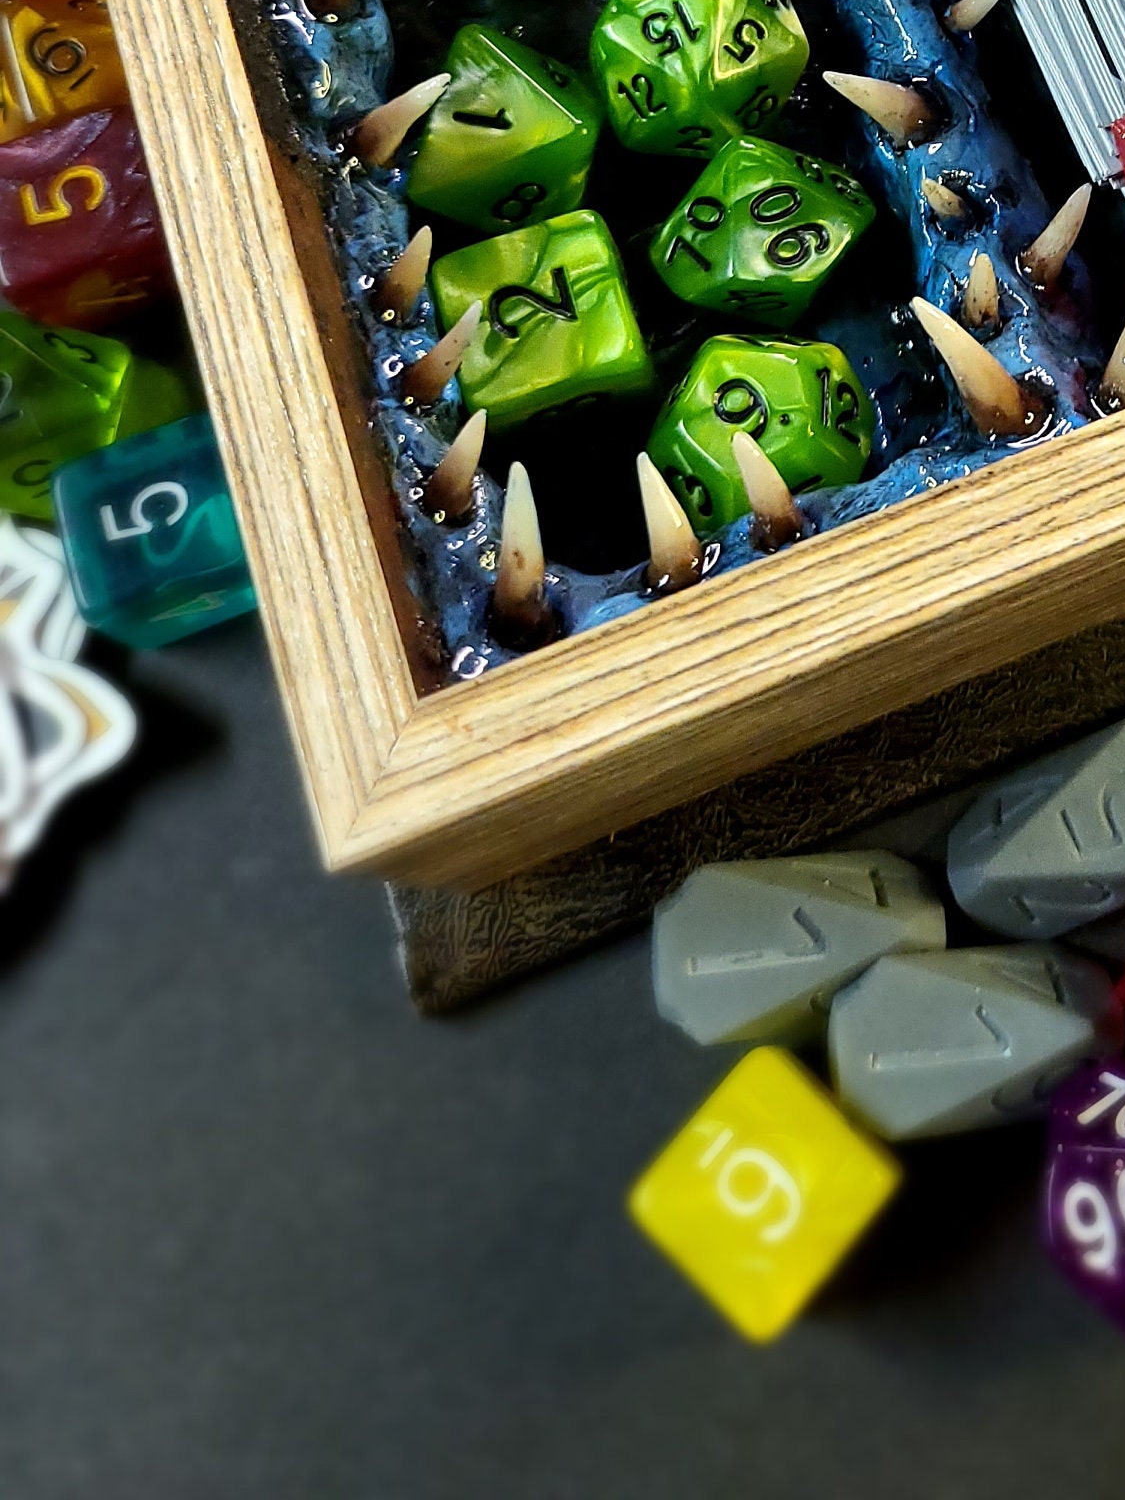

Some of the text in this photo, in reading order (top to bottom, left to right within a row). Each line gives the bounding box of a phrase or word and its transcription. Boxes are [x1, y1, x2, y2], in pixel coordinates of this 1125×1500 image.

[642, 0, 704, 57] 15
[722, 18, 769, 65] 5
[451, 107, 514, 131] 1
[616, 73, 669, 123] 12
[18, 163, 109, 227] 5
[492, 180, 548, 224] 8
[487, 265, 580, 341] 2
[816, 366, 864, 447] 12
[99, 480, 190, 542] 5
